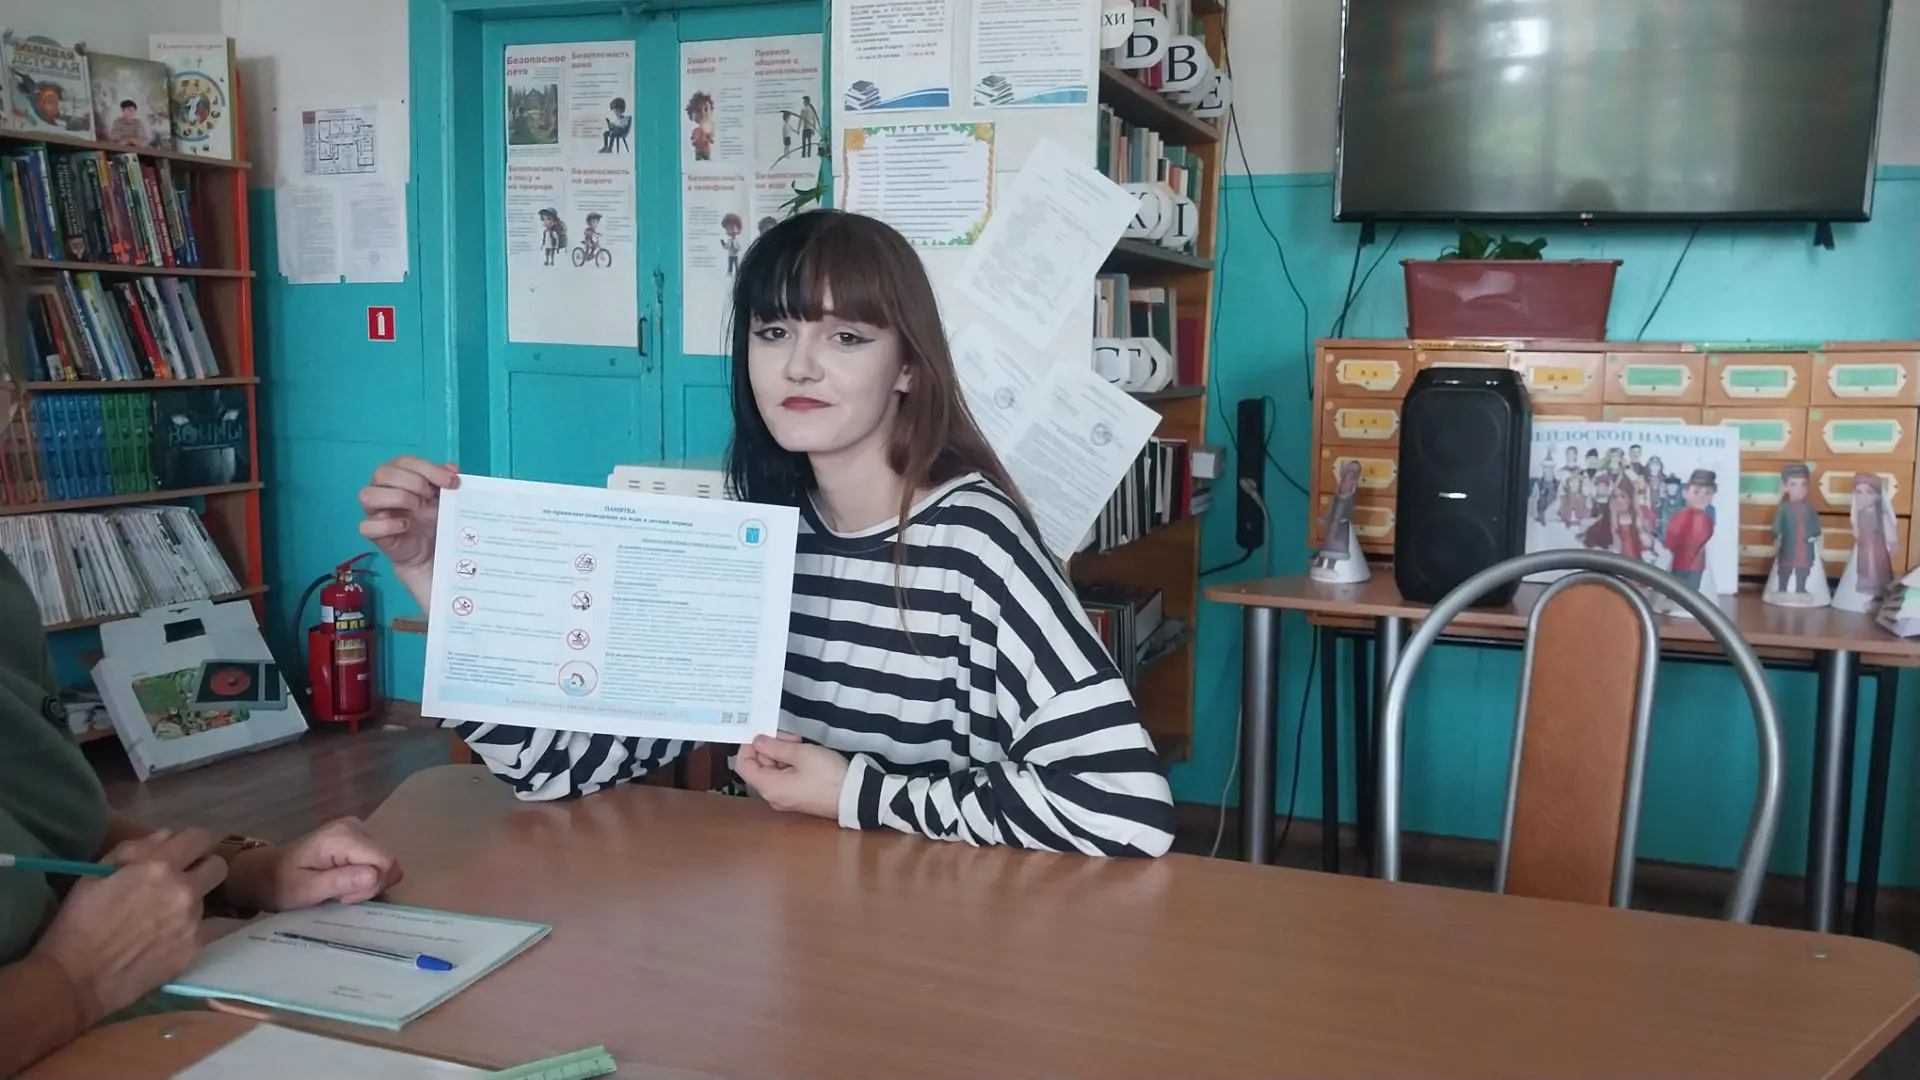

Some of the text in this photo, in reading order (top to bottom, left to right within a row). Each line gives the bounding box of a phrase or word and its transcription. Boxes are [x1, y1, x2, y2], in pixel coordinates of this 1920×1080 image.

[1100, 12, 1126, 27] ХИ
[1126, 17, 1159, 59] Б
[571, 51, 630, 59] Безопасность
[755, 48, 790, 57] Правила
[12, 54, 80, 73] ДЕТСКАЯ
[506, 55, 567, 65] Безопасное
[686, 57, 716, 65] Защита
[1166, 44, 1198, 83] В
[506, 68, 528, 77] лето
[686, 67, 715, 75] солнца
[508, 164, 564, 173] Безопасность
[571, 167, 630, 176] Безопасность
[514, 175, 533, 183] лесу
[755, 172, 814, 180] Безопасность
[583, 178, 612, 186] дороге
[1531, 428, 1726, 448] ЕЙДОСКОП НАРОДОВ
[604, 505, 636, 514] ПАМЯТКА
[585, 512, 618, 520] поведения
